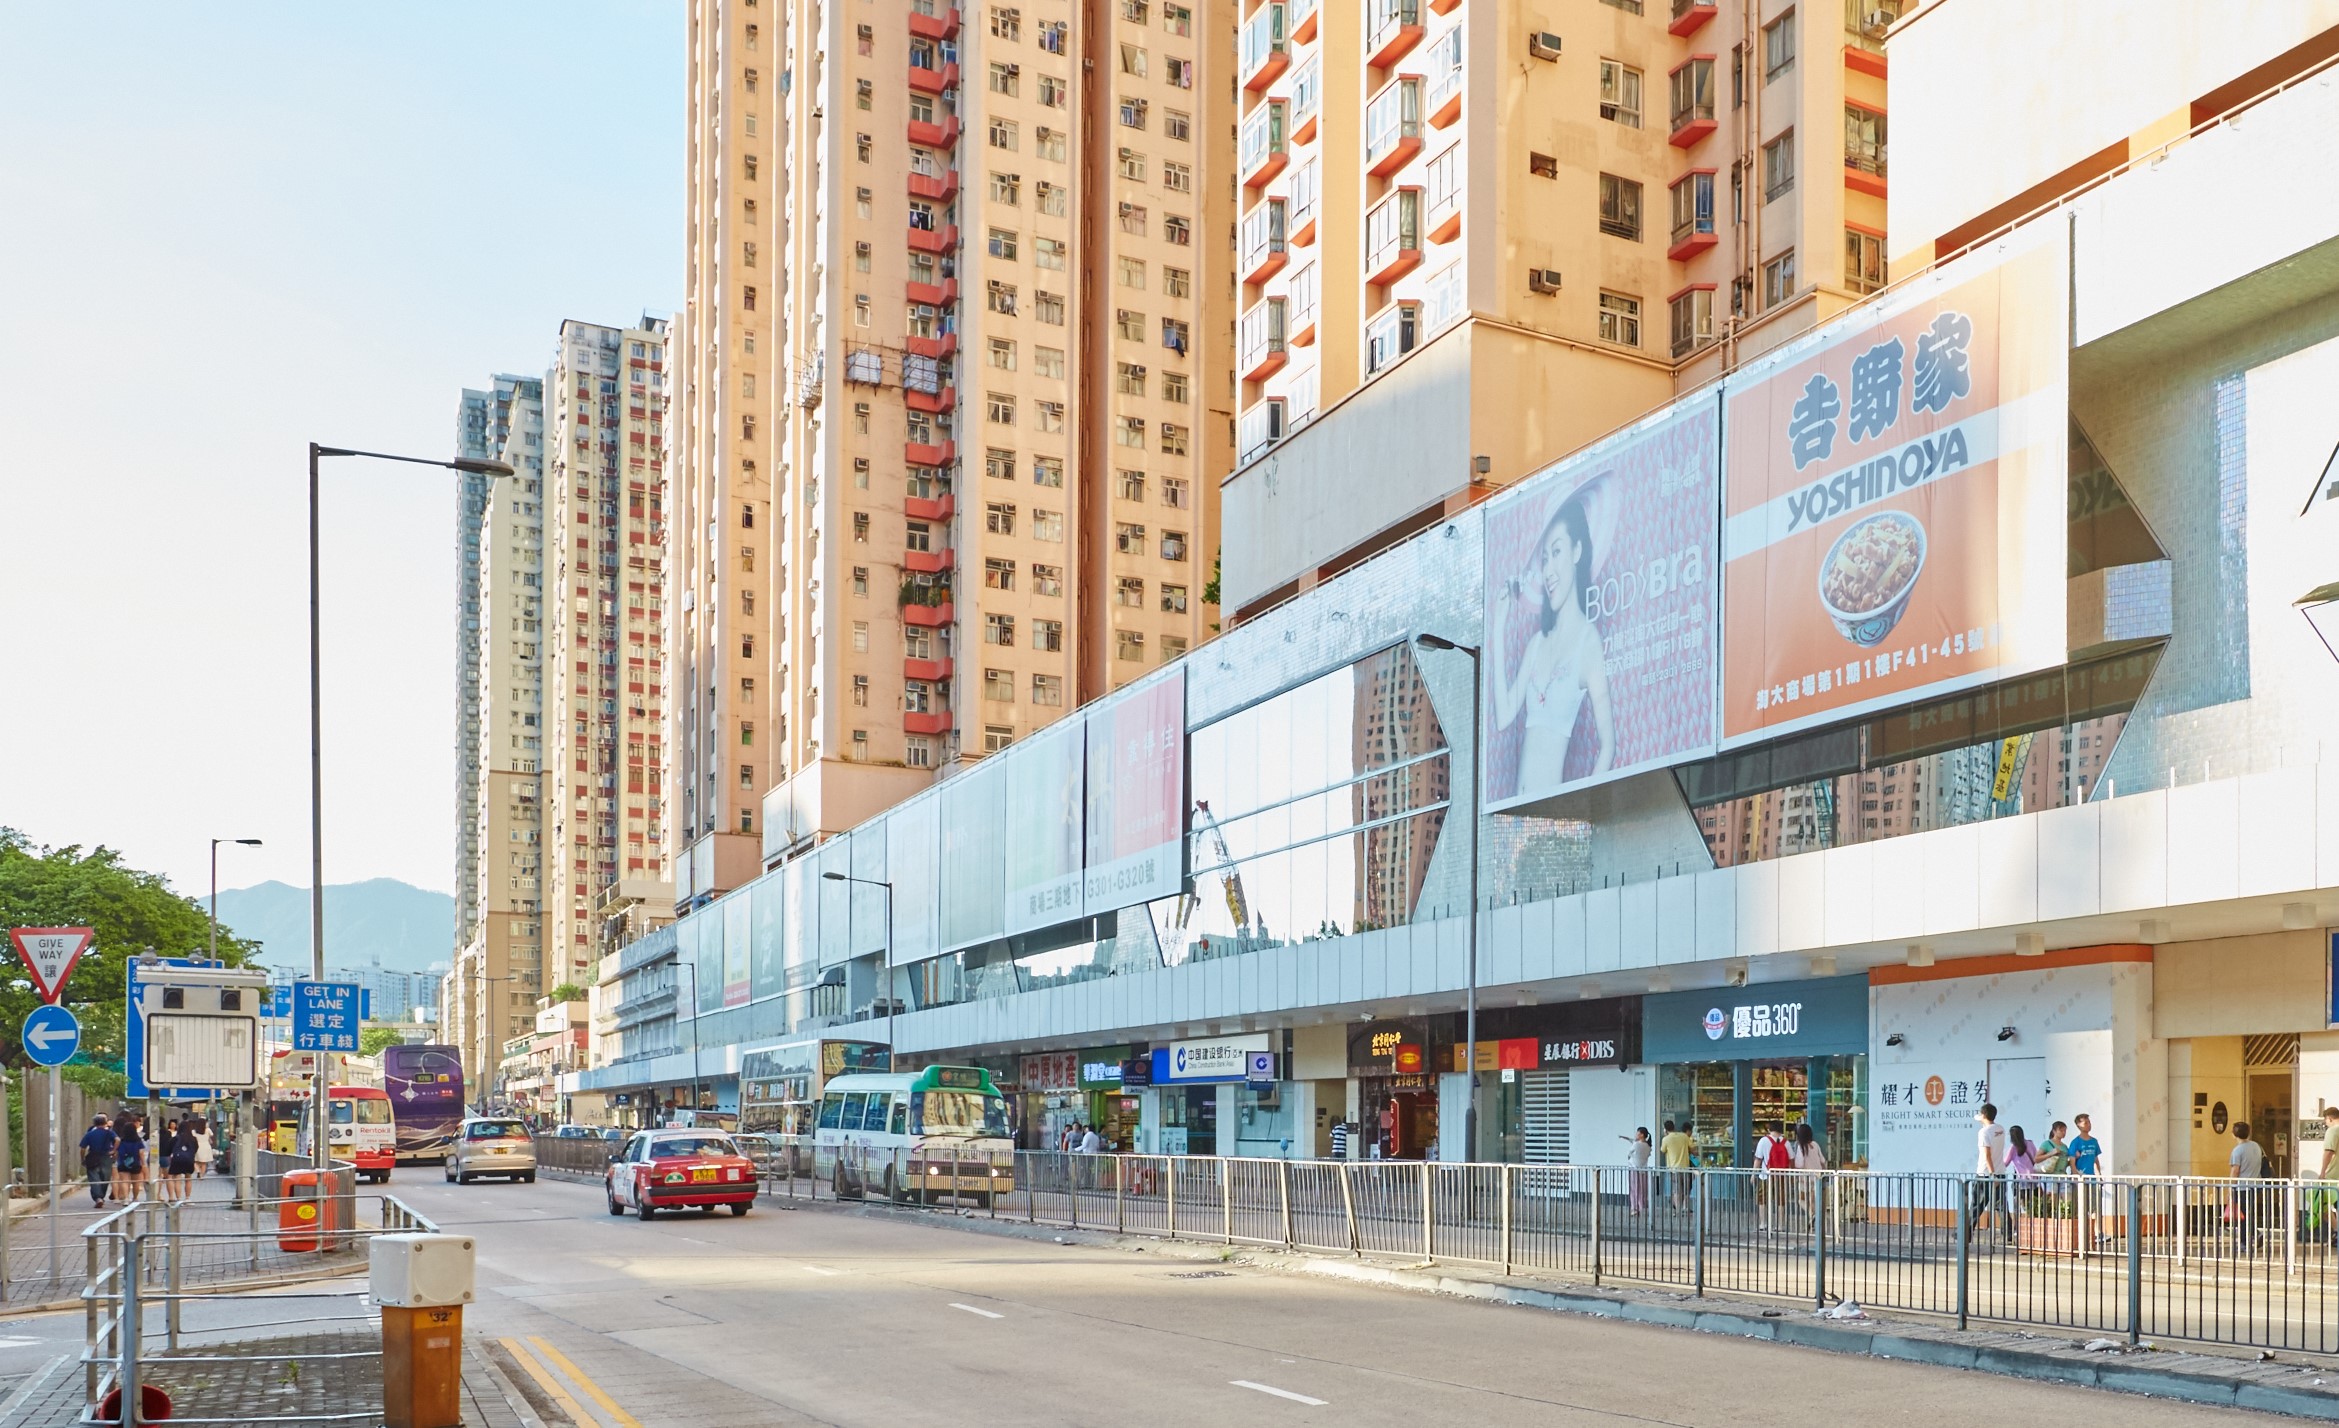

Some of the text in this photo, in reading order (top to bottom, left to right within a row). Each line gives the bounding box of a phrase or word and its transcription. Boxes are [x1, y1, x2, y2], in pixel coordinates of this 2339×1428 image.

[1788, 312, 1972, 472] 吉野家
[1787, 427, 1968, 533] YOSHINOYA
[39, 938, 64, 948] GIVE
[39, 950, 63, 960] WAY
[44, 964, 57, 978] 讓
[304, 986, 330, 997] GET
[336, 987, 350, 998] IN
[309, 999, 344, 1010] LANE
[309, 1013, 344, 1029] 選定
[1591, 1040, 1615, 1059] DBS
[1881, 1082, 1919, 1106] 耀才
[1881, 1109, 1980, 1120] BRIGHT SMART SECURIT
